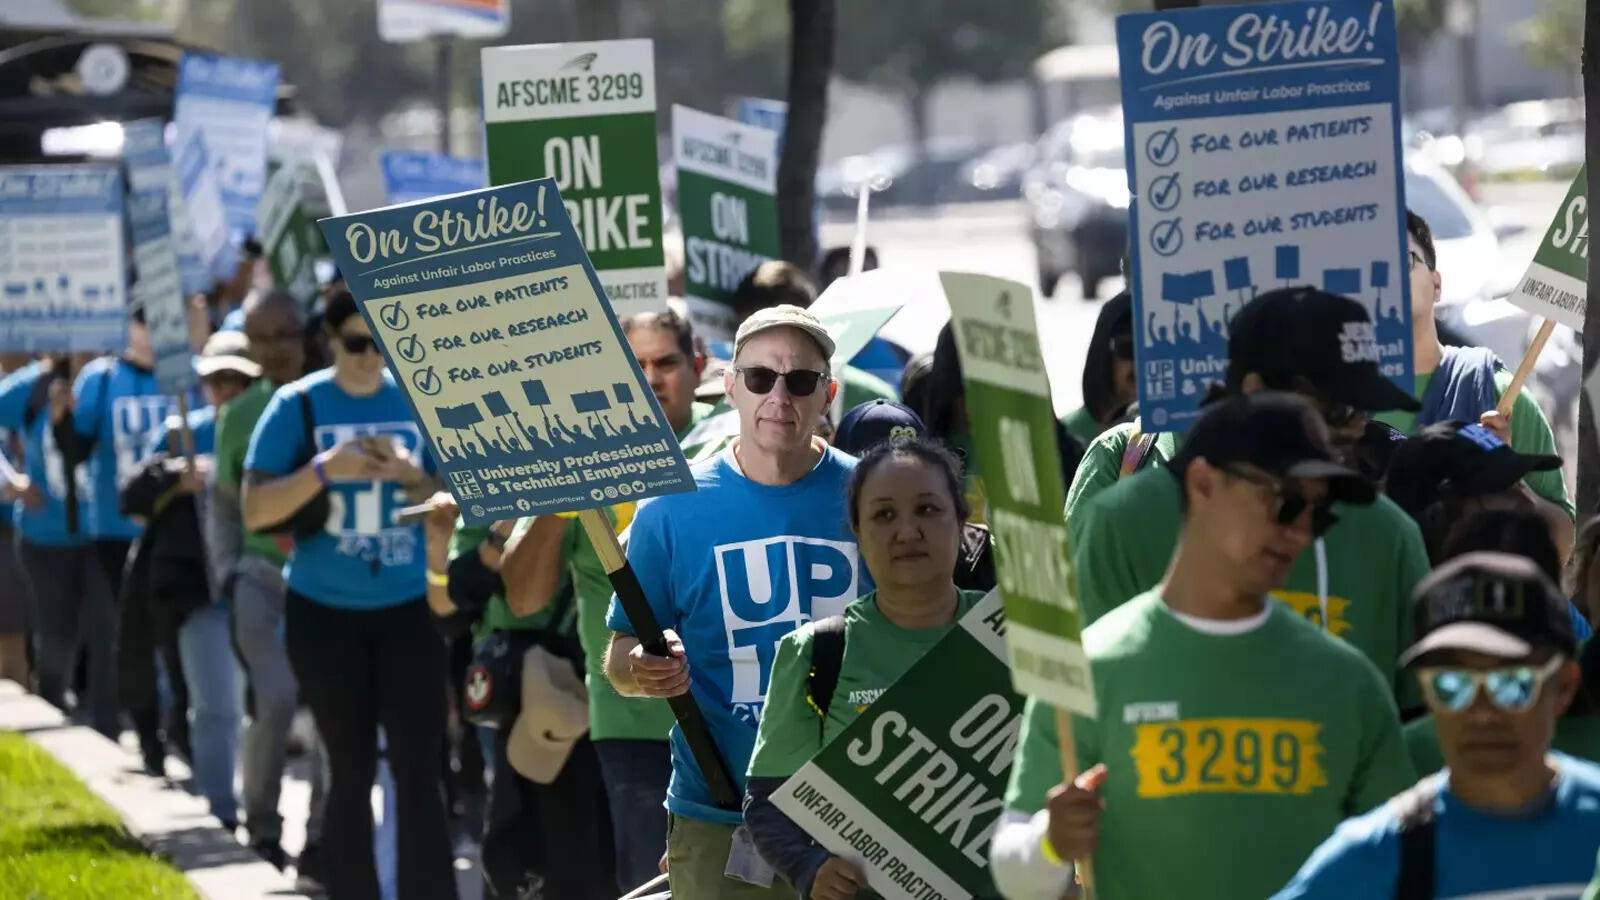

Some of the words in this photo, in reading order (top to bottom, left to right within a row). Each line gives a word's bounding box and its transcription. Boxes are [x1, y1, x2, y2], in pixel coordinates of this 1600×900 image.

[1142, 20, 1217, 75] On
[1222, 1, 1382, 67] Strike!
[497, 76, 581, 109] AFSCME
[587, 72, 643, 102] 3299
[1153, 91, 1211, 111] Against
[1214, 88, 1260, 104] Unfair
[1263, 84, 1304, 100] Labor
[1307, 79, 1371, 97] Practices
[1190, 133, 1232, 153] FOR
[1239, 129, 1278, 148] OUR
[1286, 116, 1372, 143] PATIENTS
[544, 134, 603, 192] ON
[1193, 178, 1231, 198] FOR
[1238, 173, 1278, 193] OUR
[1285, 160, 1377, 187] RESEARCH
[346, 222, 408, 264] On
[413, 185, 548, 252] Strike!
[711, 191, 748, 245] ON
[1195, 221, 1236, 242] FOR
[1243, 216, 1284, 236] OUR
[1290, 203, 1379, 231] STUDENTS
[373, 273, 419, 289] Against
[421, 262, 458, 281] Unfair
[461, 259, 496, 275] Labor
[500, 248, 556, 267] Practices
[416, 303, 451, 320] FOR
[456, 295, 490, 312] OUR
[494, 276, 569, 304] PATIENTS
[433, 335, 466, 351] FOR
[470, 327, 504, 344] OUR
[508, 308, 589, 337] RESEARCH
[448, 367, 484, 384] FOR
[488, 360, 522, 377] OUR
[524, 340, 603, 369] STUDENTS
[478, 458, 561, 480] University
[563, 438, 670, 469] Professional
[486, 482, 500, 495] &
[500, 468, 581, 493] Technical
[582, 455, 676, 482] Employees
[722, 541, 853, 622] UP
[1159, 727, 1300, 788] 3299
[792, 780, 848, 831] UNFAIR
[839, 815, 888, 866] LABOR
